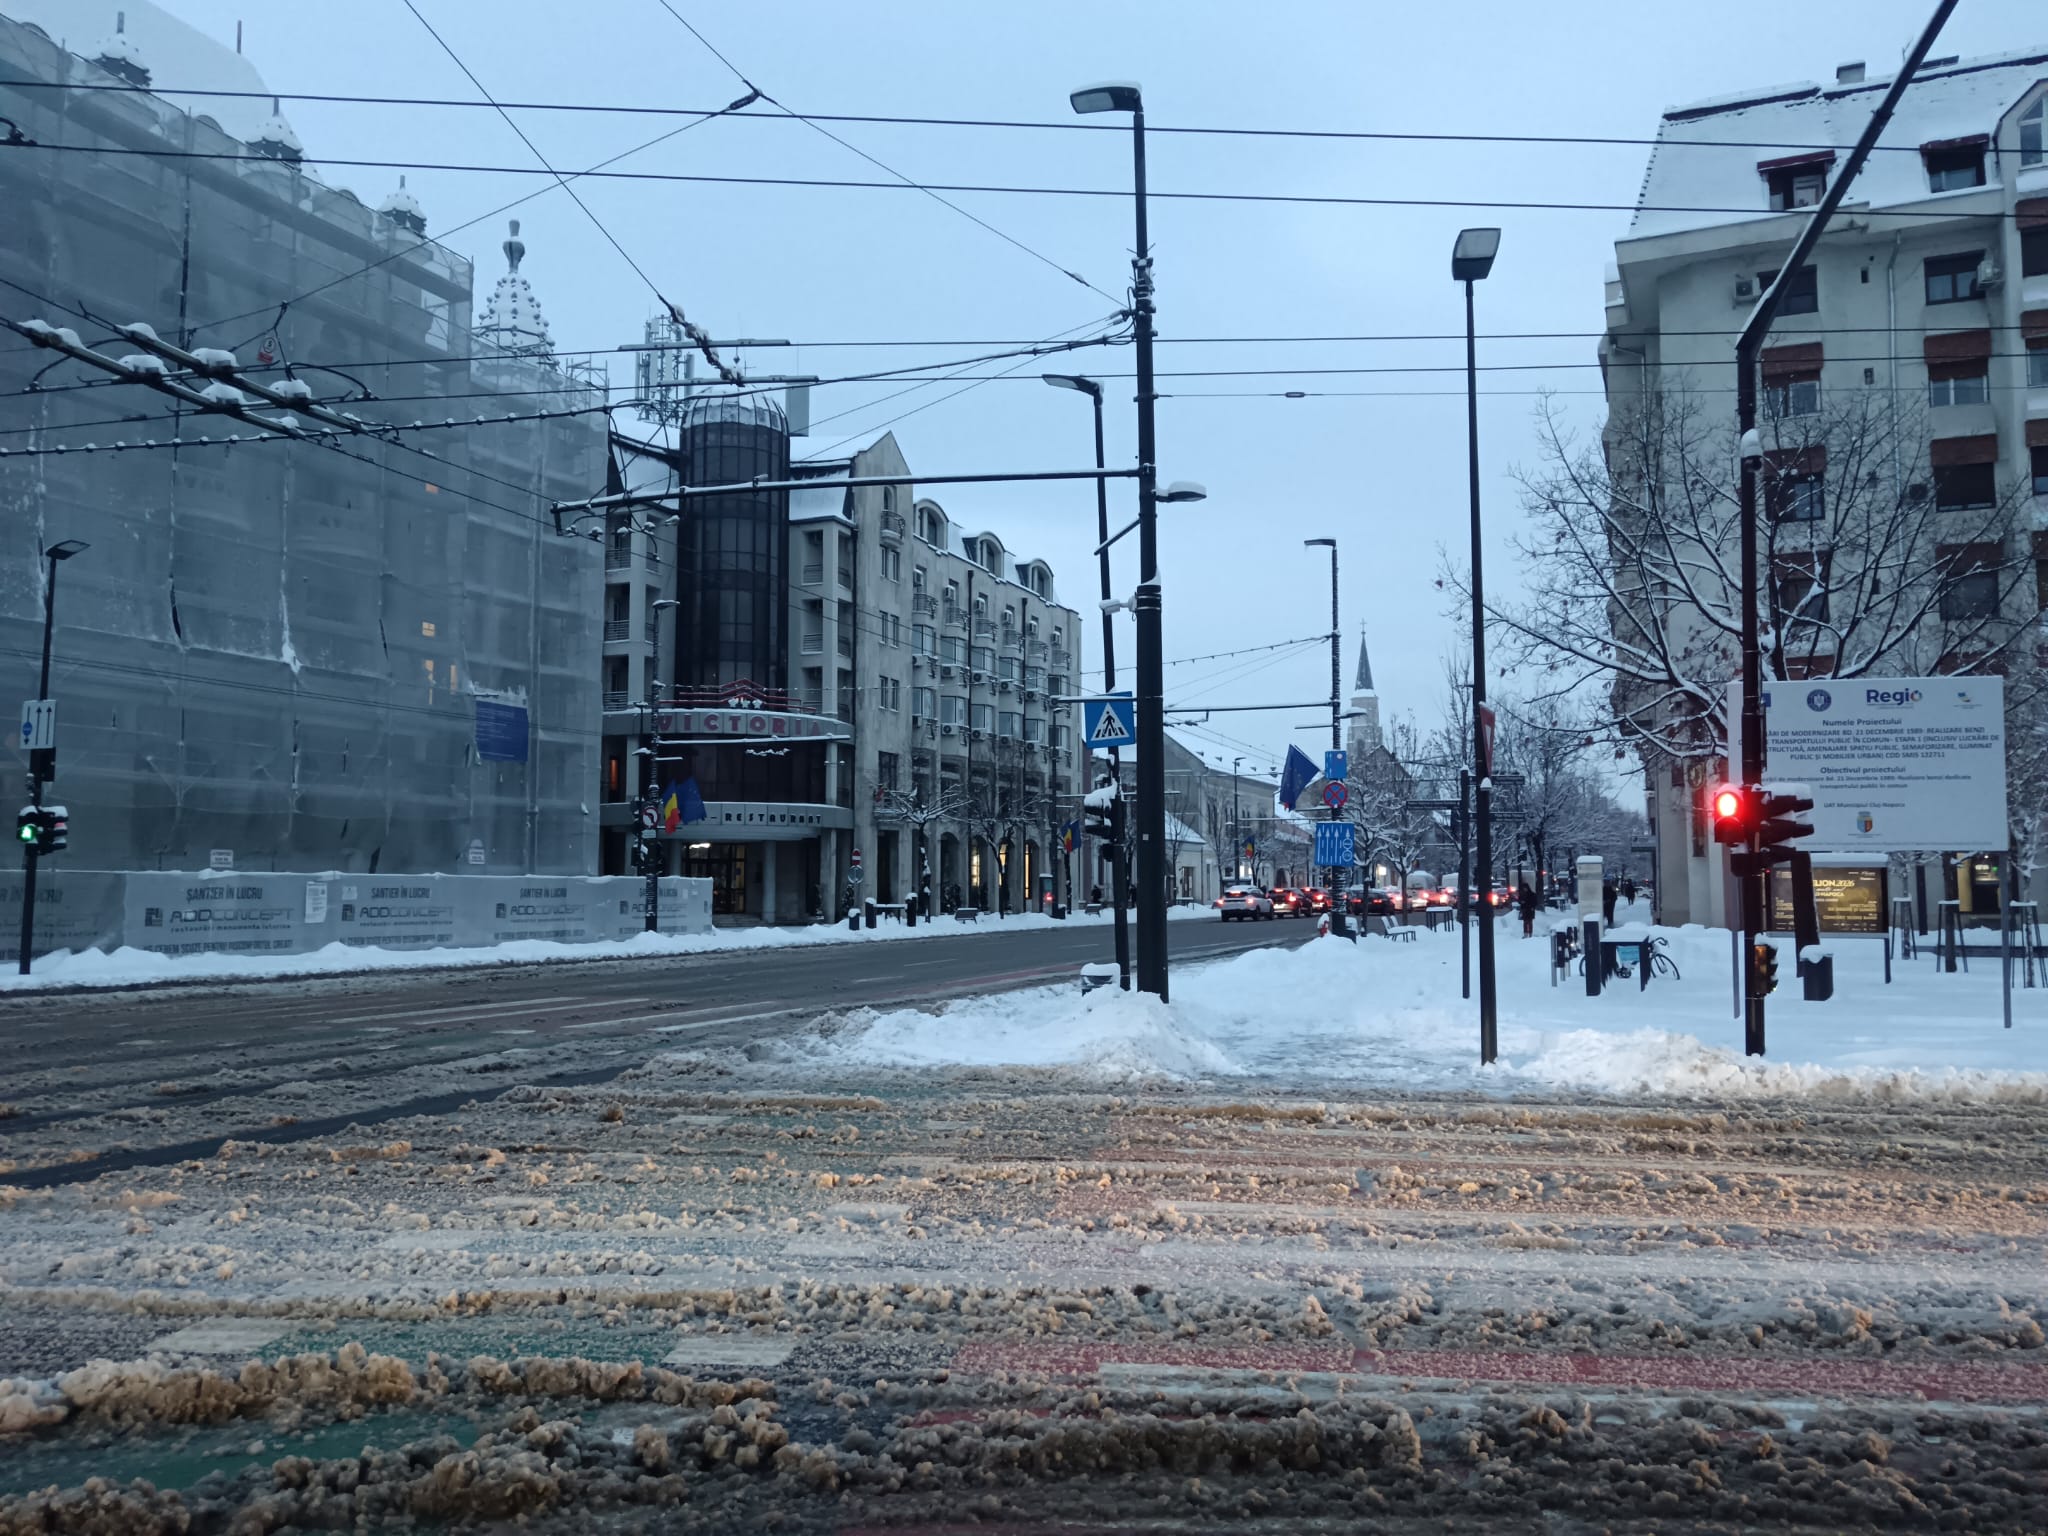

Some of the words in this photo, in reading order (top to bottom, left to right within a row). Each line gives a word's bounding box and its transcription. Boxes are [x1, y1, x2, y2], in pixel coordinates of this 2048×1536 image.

[1866, 688, 1924, 706] Regio
[657, 713, 821, 736] VICTORIA
[1857, 718, 1902, 726] Proiectului
[1820, 766, 1861, 774] Obiectivul
[1862, 766, 1906, 774] proiectului
[725, 812, 822, 825] RESTAURANT
[236, 886, 263, 900] LUCRU
[409, 887, 431, 899] LUCRU
